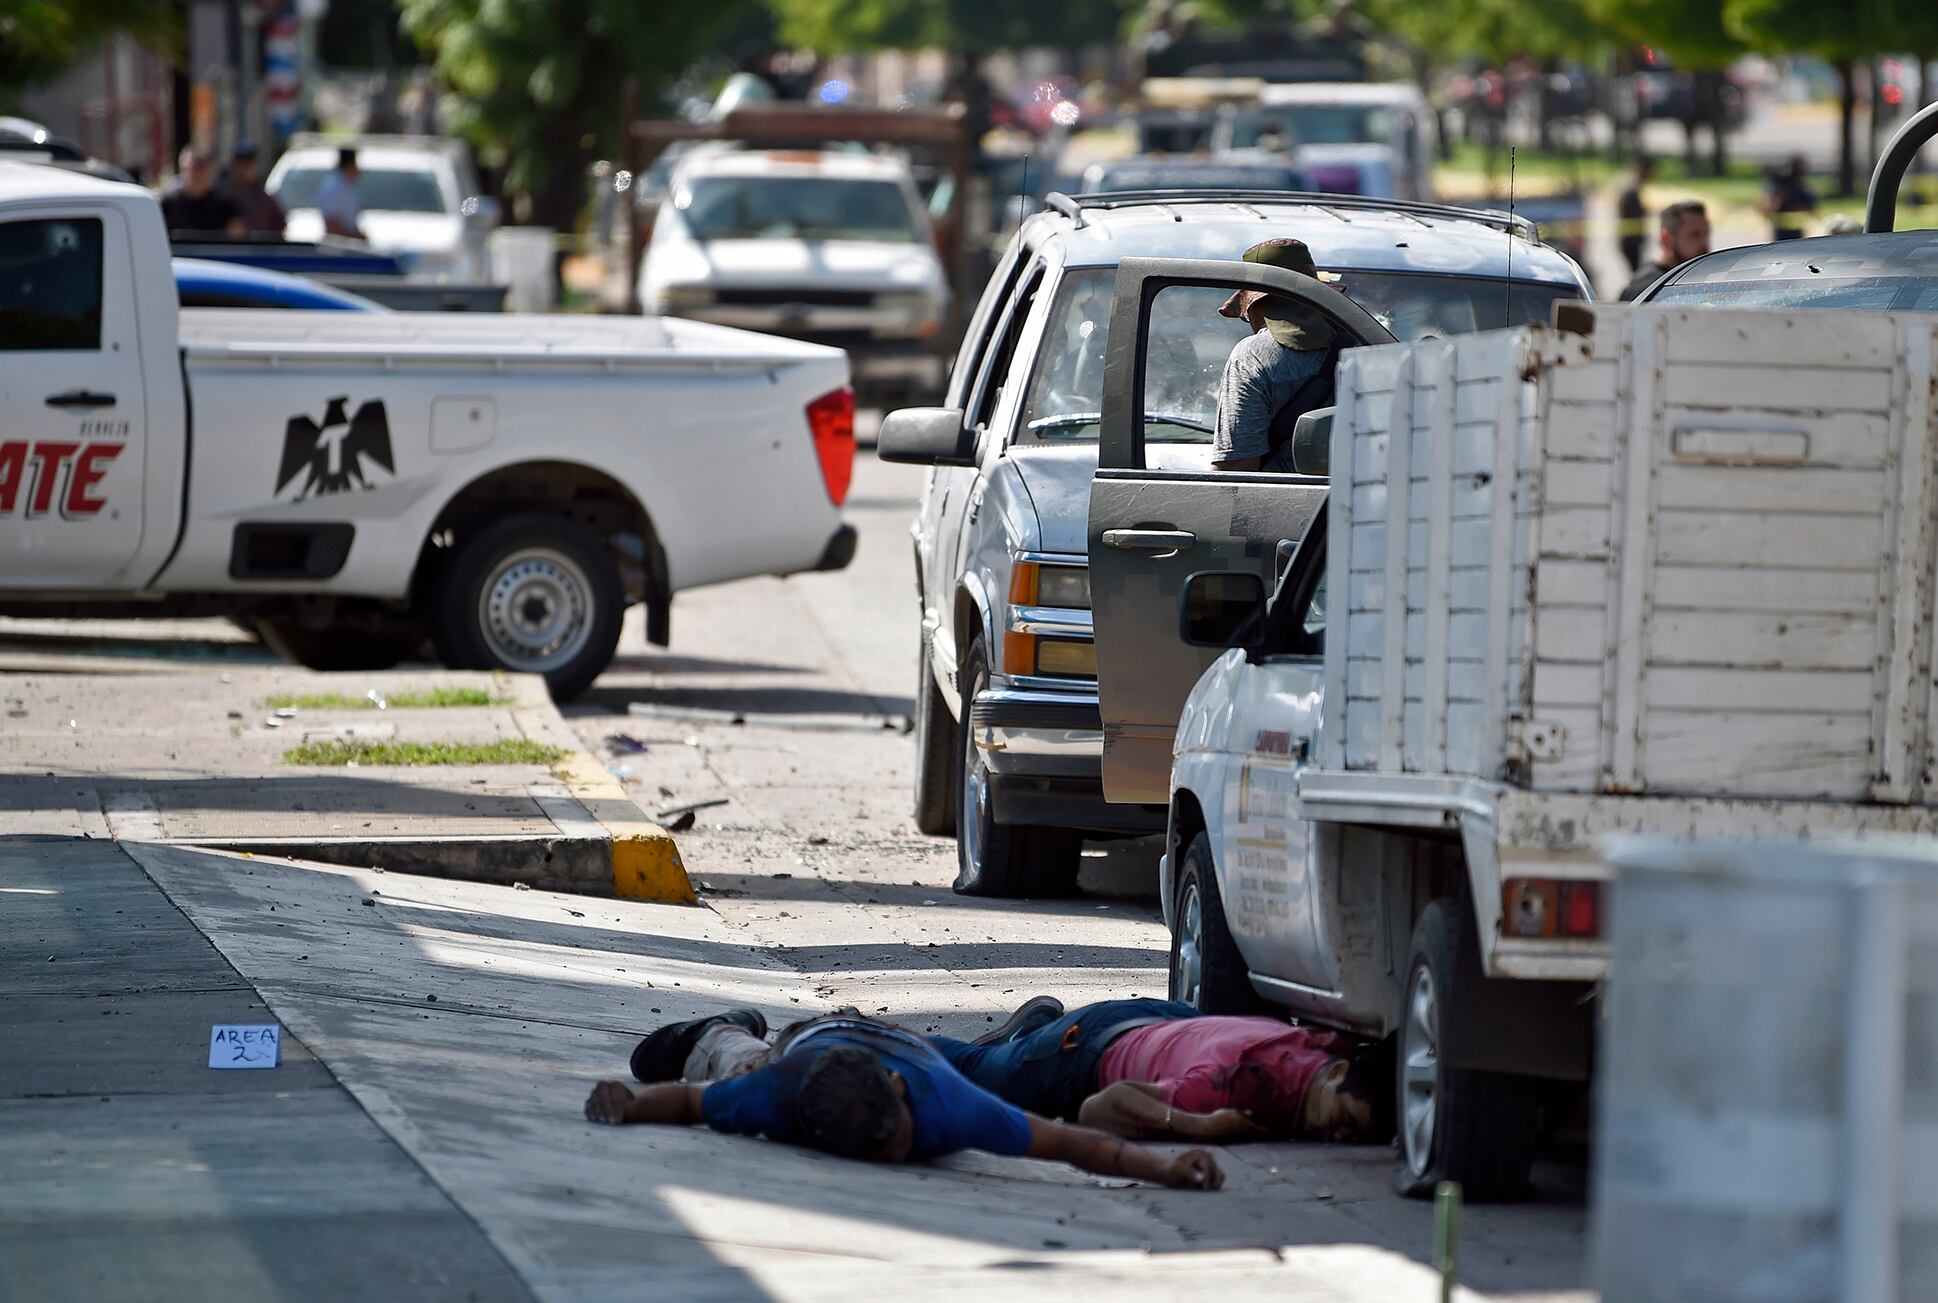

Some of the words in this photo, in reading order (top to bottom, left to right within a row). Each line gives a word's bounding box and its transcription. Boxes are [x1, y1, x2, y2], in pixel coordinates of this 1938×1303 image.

[315, 422, 352, 475] T
[215, 1029, 277, 1045] AREA
[232, 1046, 258, 1062] 2
